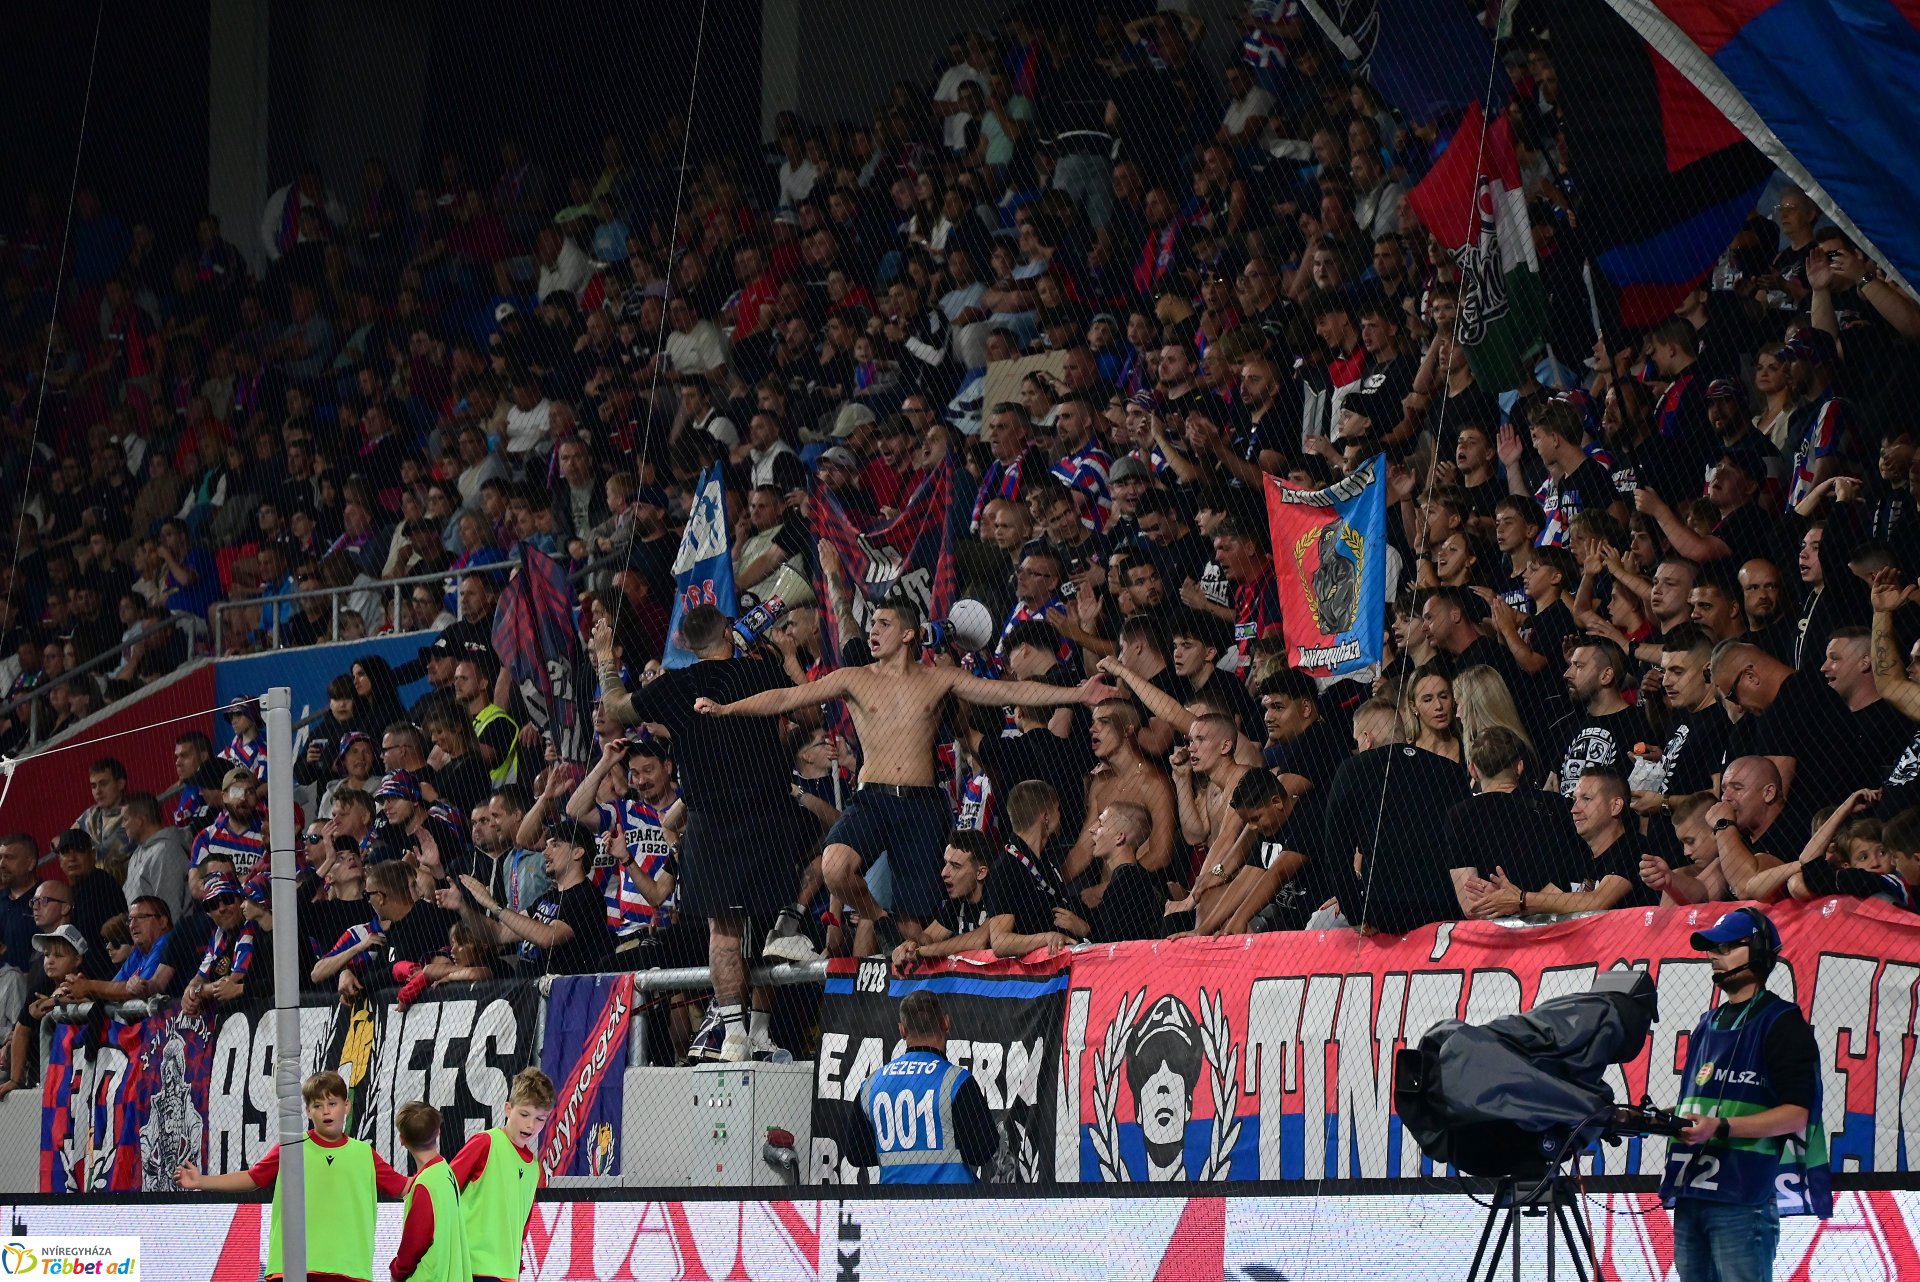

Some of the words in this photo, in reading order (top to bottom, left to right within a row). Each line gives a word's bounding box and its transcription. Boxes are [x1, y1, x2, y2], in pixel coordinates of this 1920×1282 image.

[641, 842, 668, 855] 1928
[856, 961, 887, 993] 1928
[818, 1033, 1044, 1110] EAERN
[882, 1059, 938, 1076] VEZETŐ
[873, 1089, 936, 1151] 001
